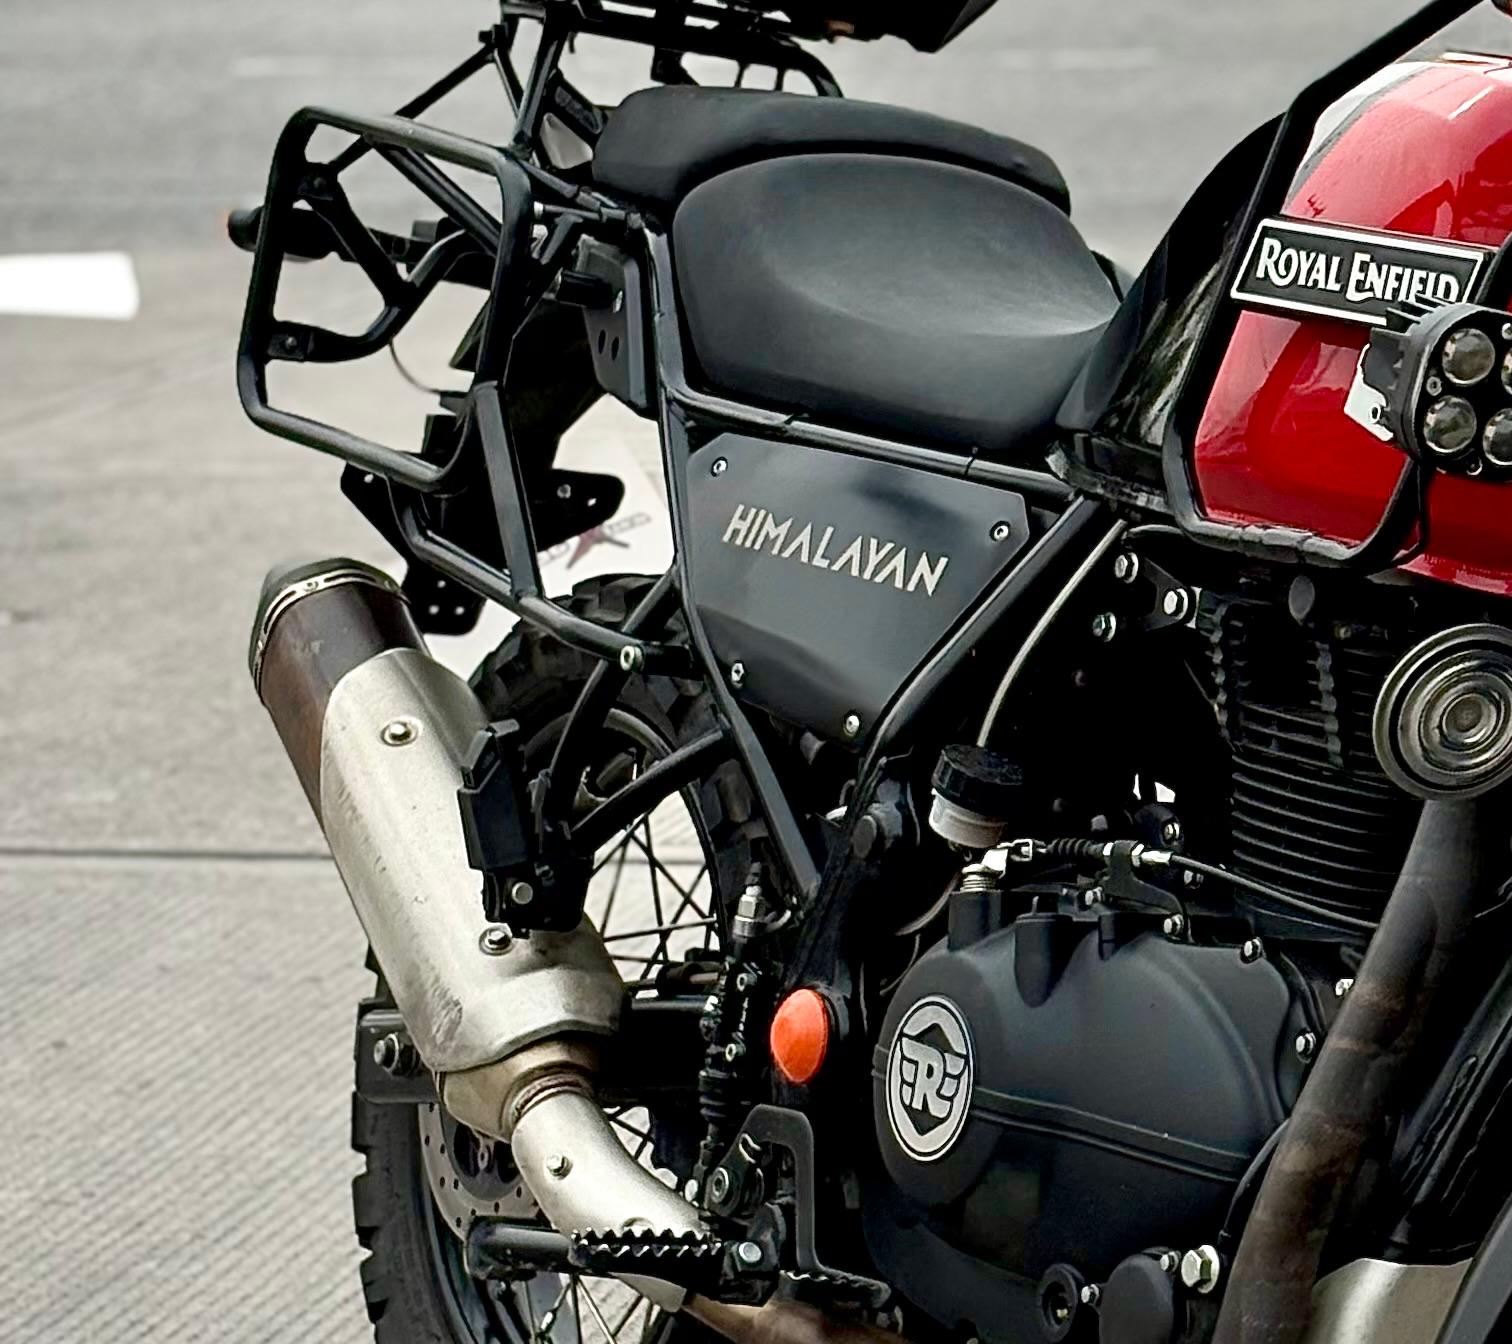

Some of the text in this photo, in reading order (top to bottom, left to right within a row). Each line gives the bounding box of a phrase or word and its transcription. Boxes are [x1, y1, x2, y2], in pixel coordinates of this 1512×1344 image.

[1256, 237, 1461, 303] ROYAL ENFIELD
[722, 503, 949, 597] HIMALAYAN
